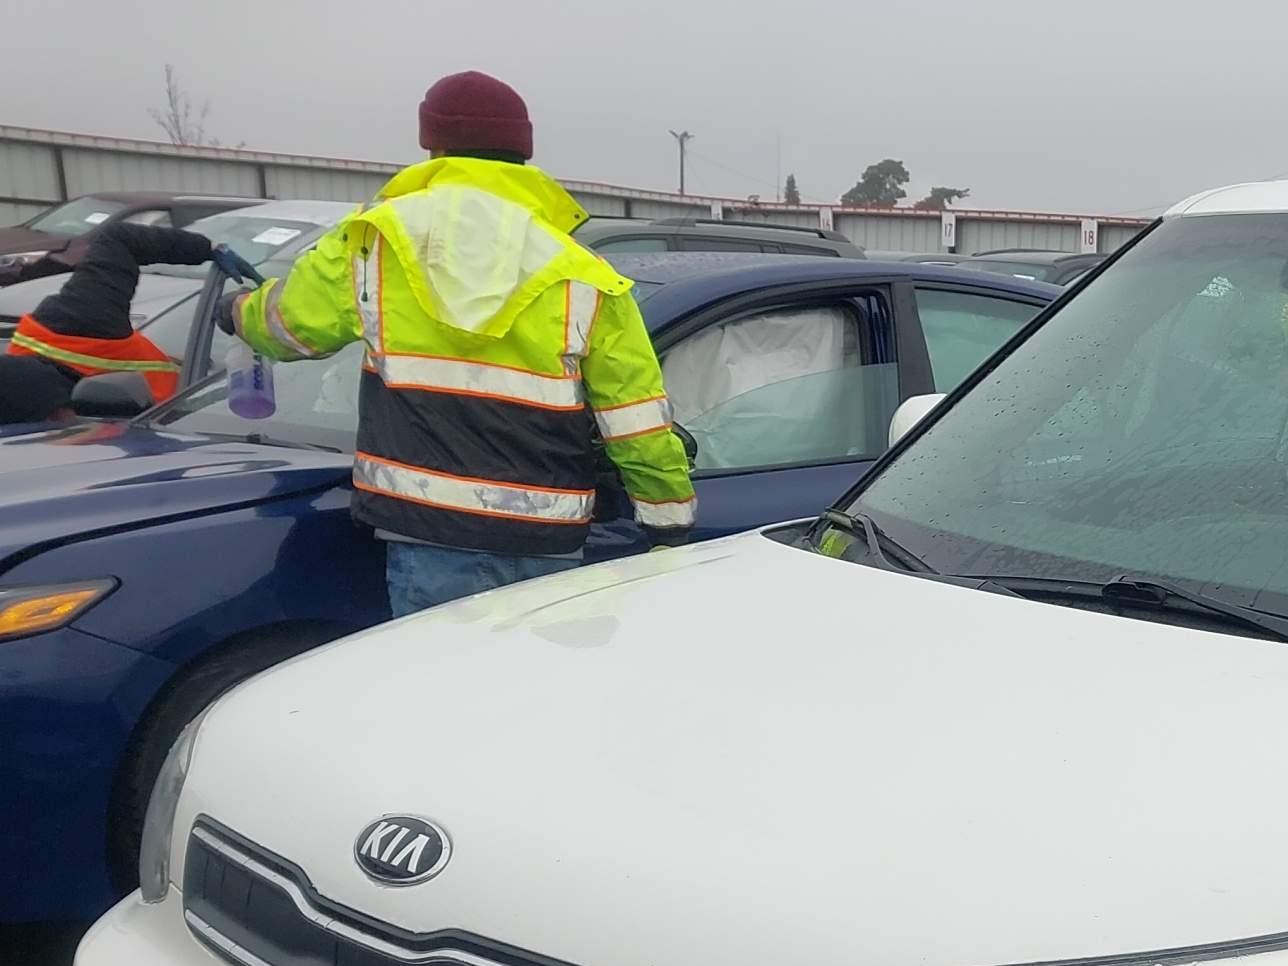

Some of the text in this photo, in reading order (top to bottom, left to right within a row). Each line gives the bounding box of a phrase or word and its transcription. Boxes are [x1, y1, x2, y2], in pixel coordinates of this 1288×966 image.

[944, 223, 953, 237] 17
[1084, 230, 1094, 245] 18
[360, 820, 431, 874] KIA
